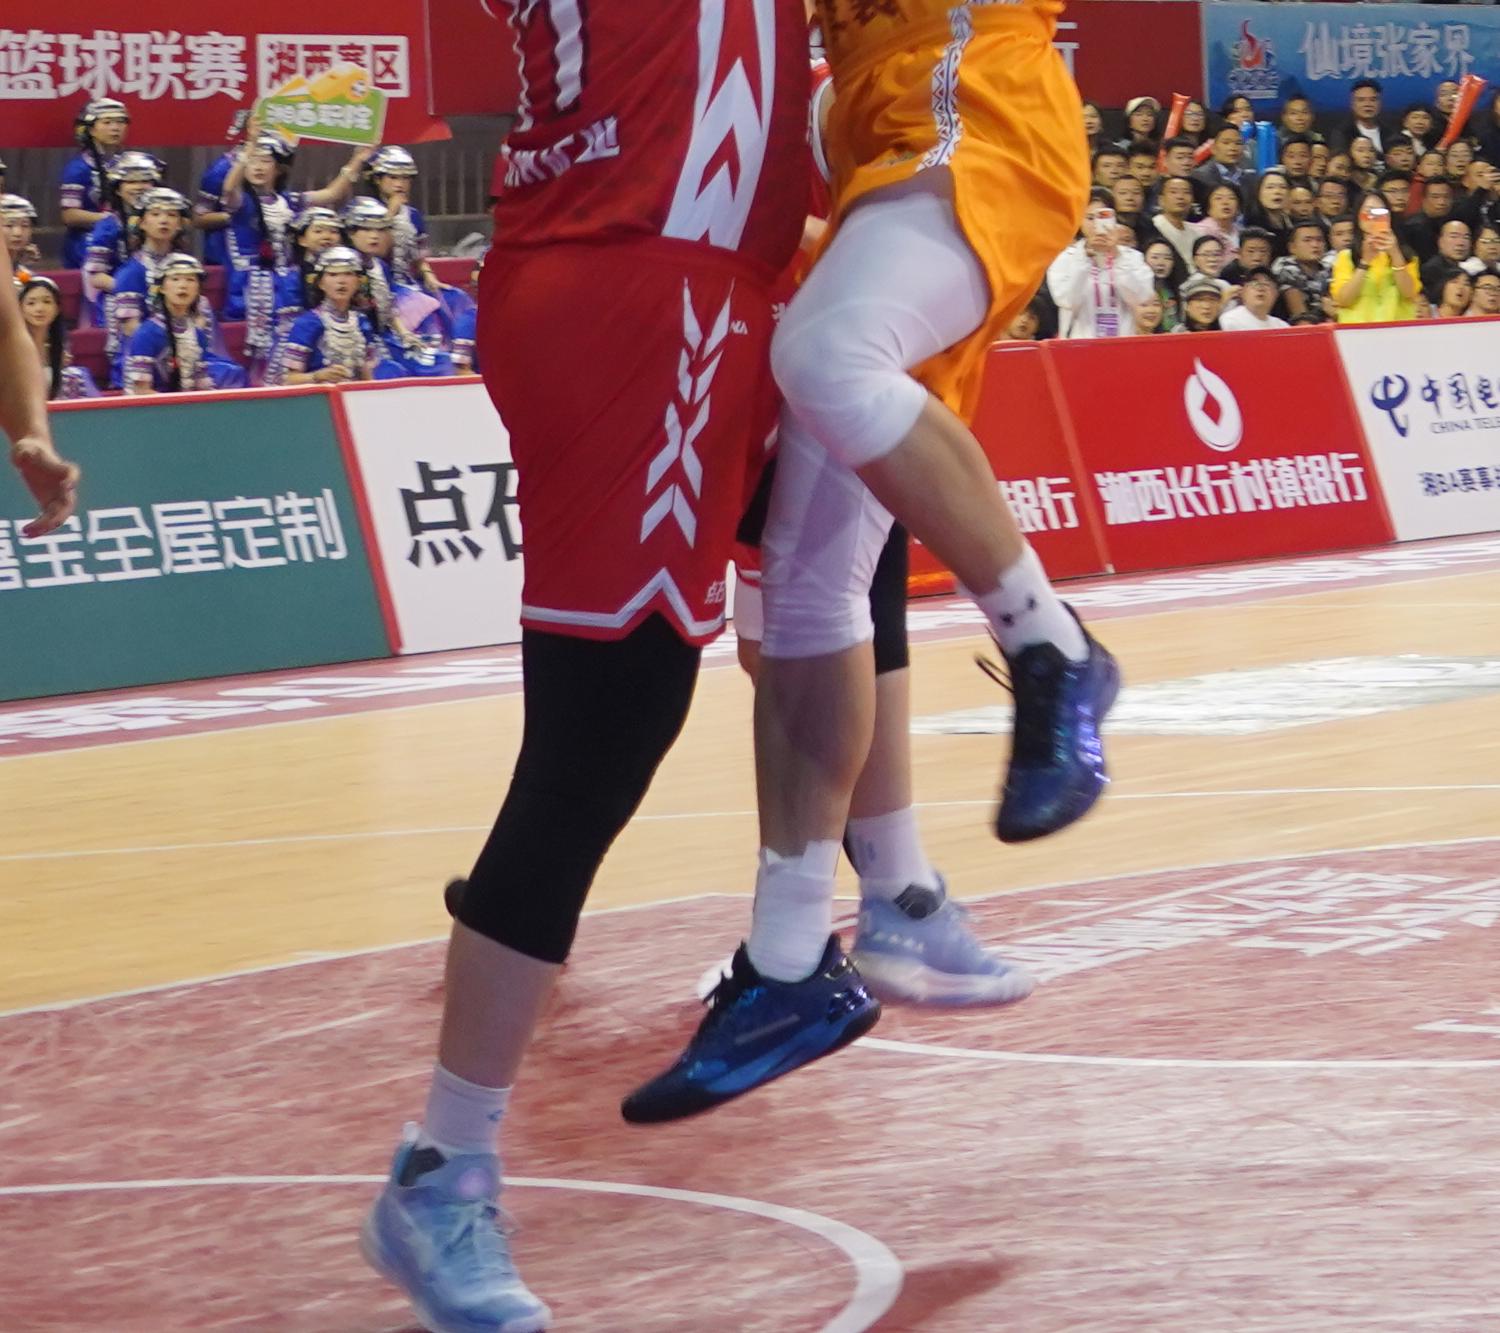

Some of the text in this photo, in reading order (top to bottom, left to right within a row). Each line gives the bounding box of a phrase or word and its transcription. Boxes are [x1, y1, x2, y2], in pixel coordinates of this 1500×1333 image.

[1096, 453, 1368, 528] 湘西长行村镇银行
